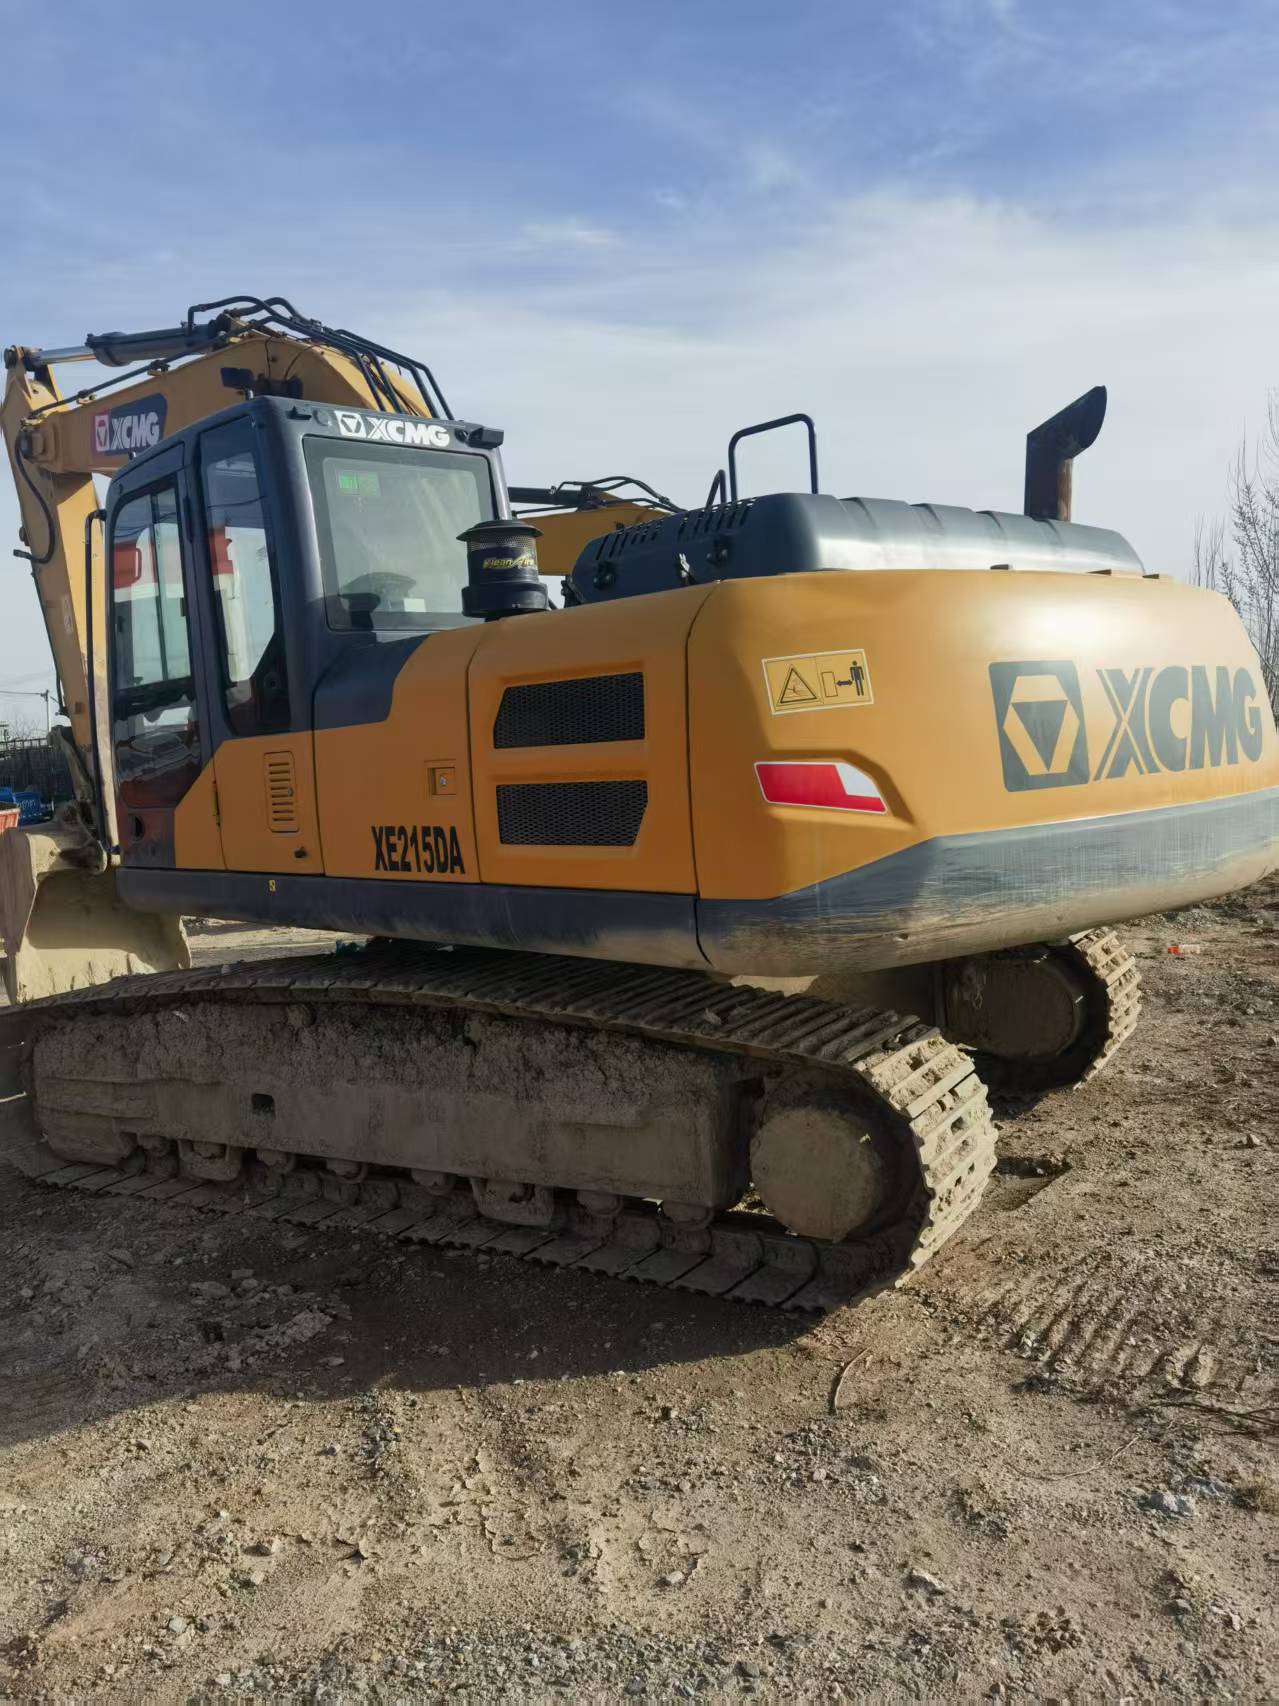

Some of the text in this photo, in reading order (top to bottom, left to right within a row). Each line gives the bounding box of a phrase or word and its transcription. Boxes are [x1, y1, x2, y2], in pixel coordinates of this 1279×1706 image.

[111, 412, 160, 449] XCMG
[366, 417, 450, 447] XCMG
[1093, 665, 1263, 781] XCMG
[371, 825, 465, 874] XE215DA
